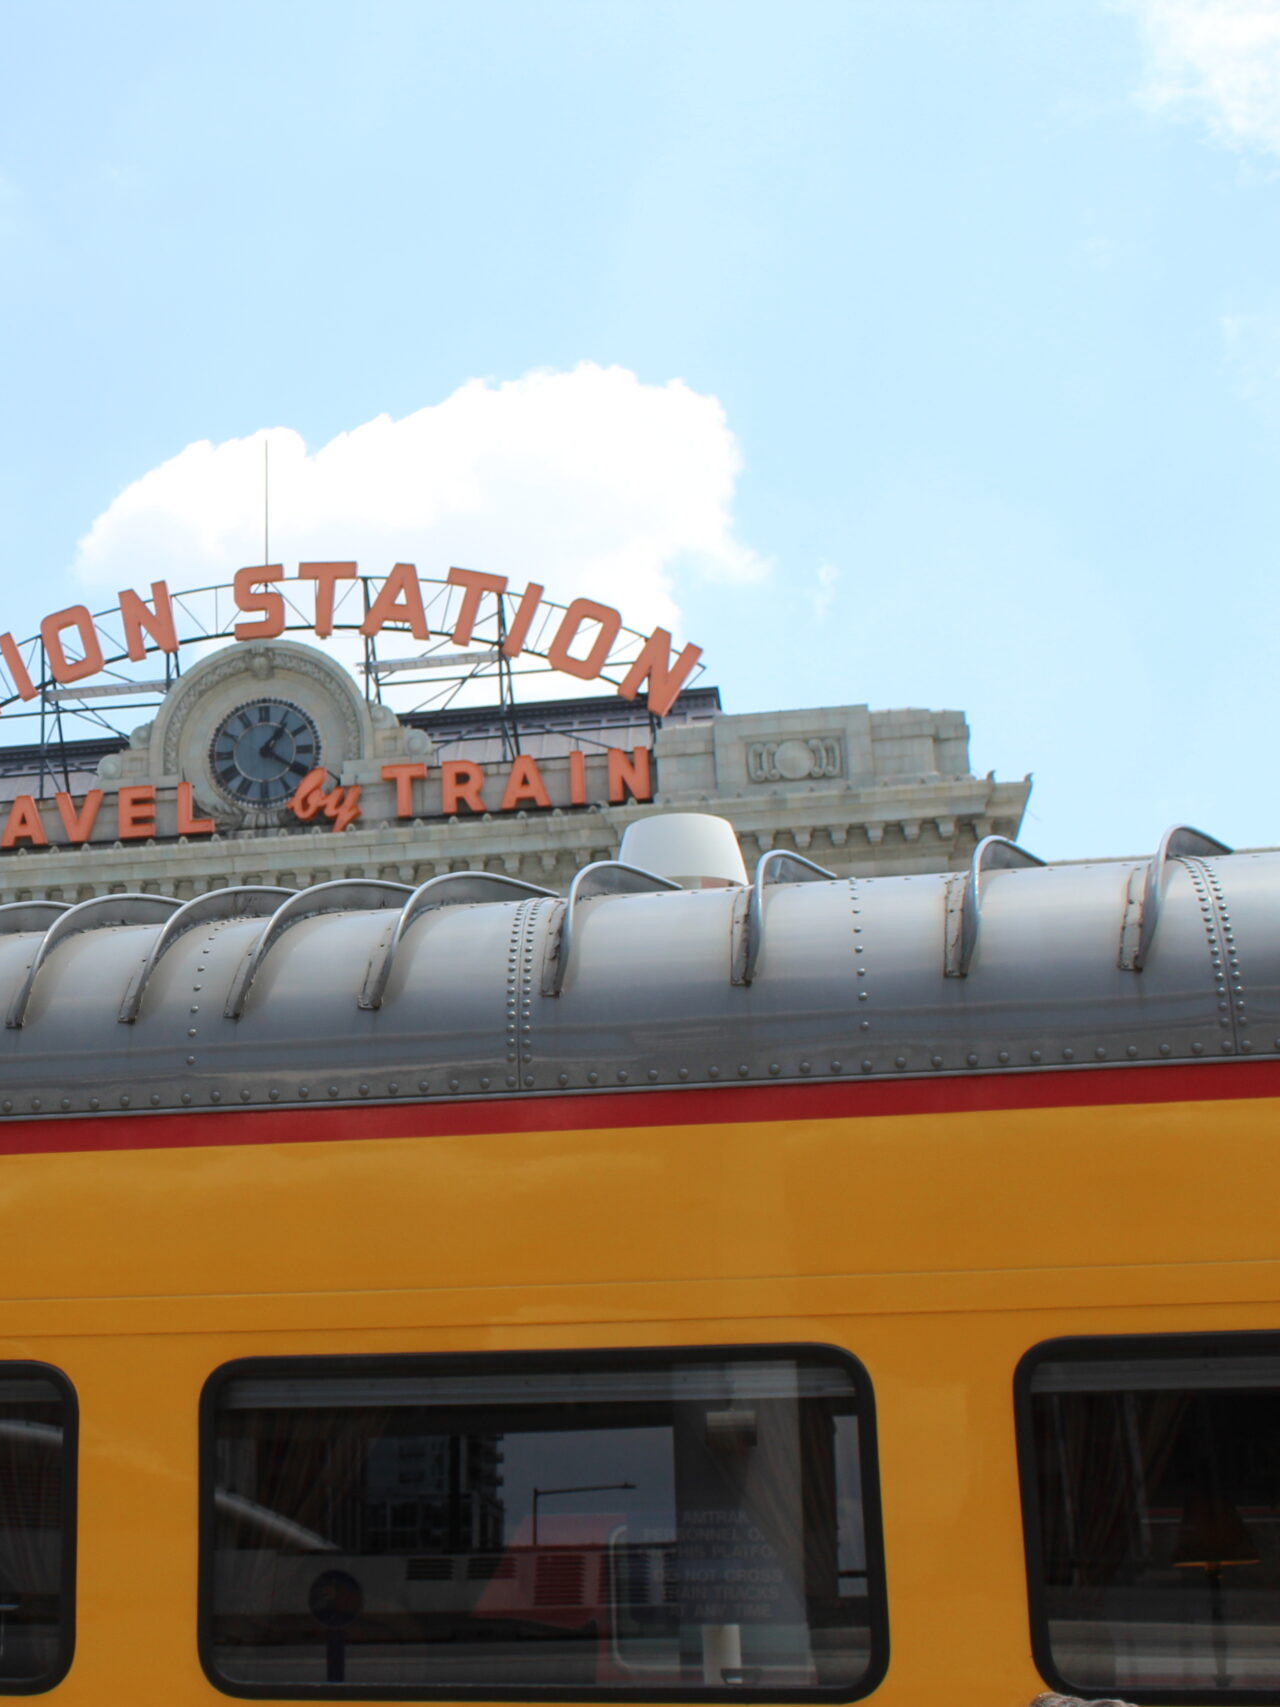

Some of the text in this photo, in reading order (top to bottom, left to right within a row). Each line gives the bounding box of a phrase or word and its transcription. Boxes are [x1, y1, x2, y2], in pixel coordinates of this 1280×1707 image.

[233, 560, 704, 717] STATION
[286, 766, 363, 833] by
[381, 746, 652, 818] TRAIN
